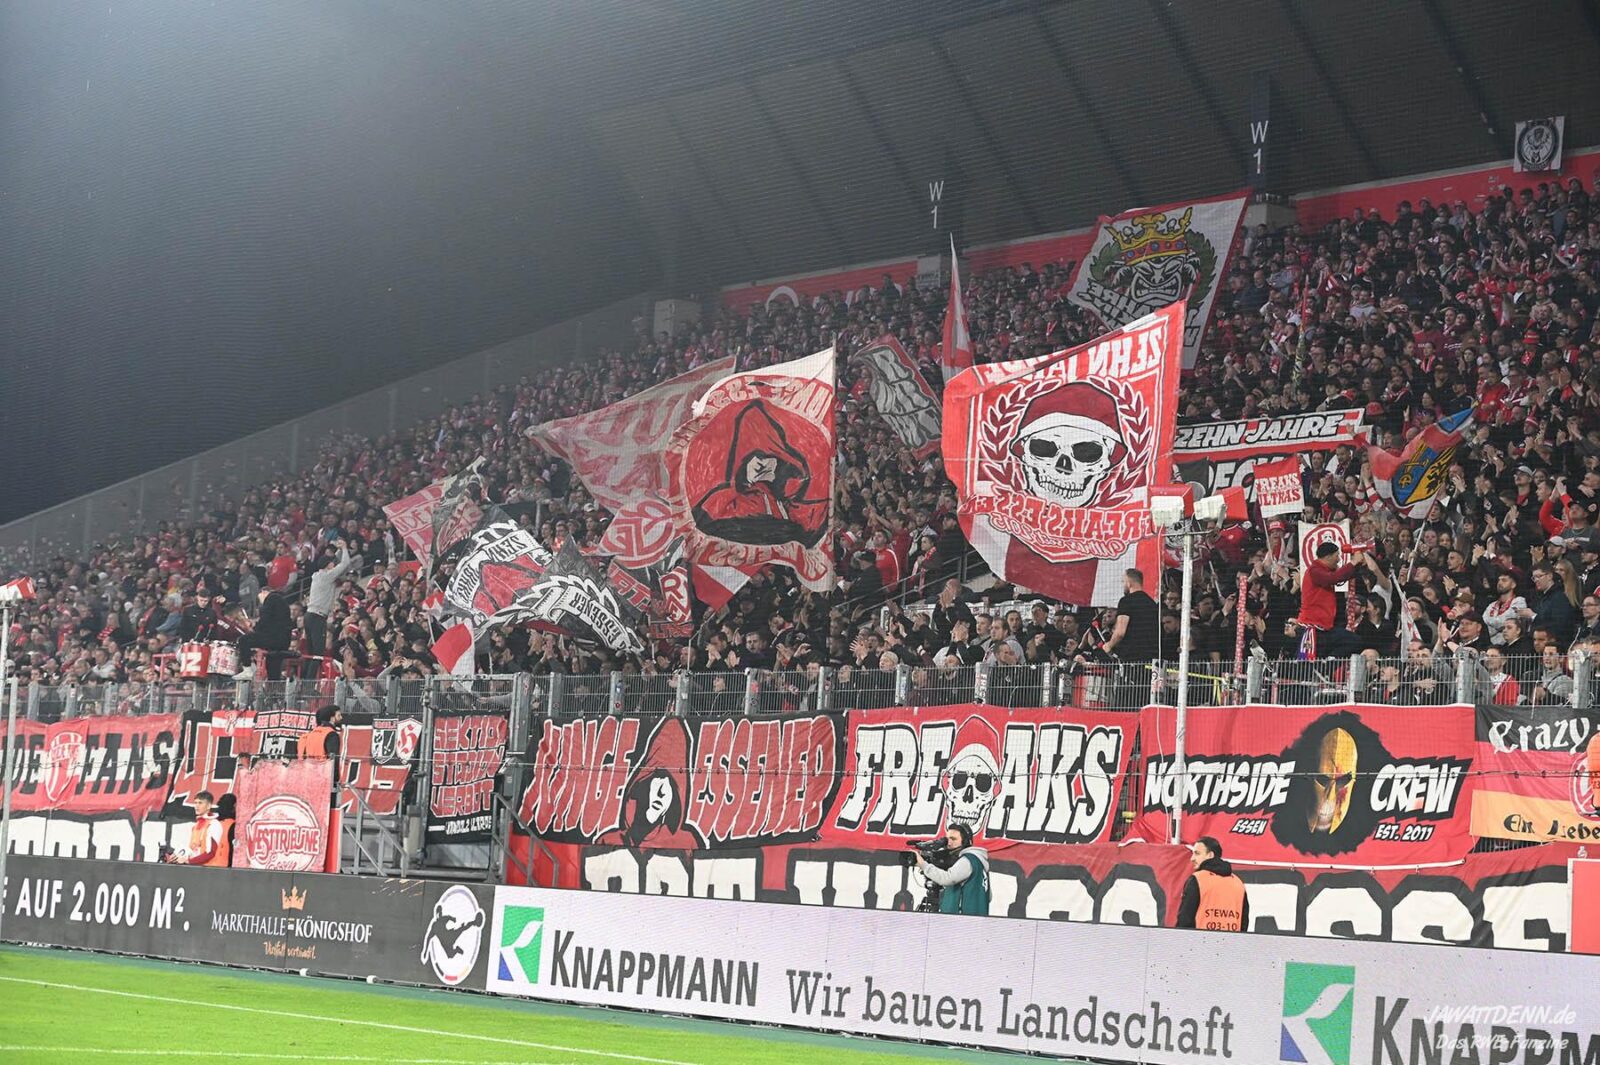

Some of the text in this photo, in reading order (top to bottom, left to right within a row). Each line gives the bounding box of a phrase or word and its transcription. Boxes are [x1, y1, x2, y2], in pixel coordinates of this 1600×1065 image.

[1251, 121, 1269, 144] W
[1253, 148, 1262, 174] 1
[929, 180, 944, 201] W
[930, 205, 938, 229] 1
[1175, 413, 1346, 448] ZEHN JAHRE
[1255, 473, 1300, 493] FREAKS
[1257, 488, 1301, 506] ULTRAS
[1488, 717, 1591, 755] Crazy
[75, 731, 175, 795] FANS
[518, 716, 641, 837] JUNGE
[688, 714, 838, 842] ESSENER
[430, 779, 495, 818] VERBOT
[836, 721, 1123, 843] FREAKS
[1144, 760, 1462, 813] NORTHSIDE CREW
[1232, 818, 1266, 835] ESSEN
[1375, 824, 1434, 841] EST. 2011
[15, 877, 63, 919] AUF
[69, 880, 140, 927] 2.000
[1205, 908, 1240, 920] STEWAD
[211, 909, 374, 944] MARKTHALLE KÖNIGSHOF
[550, 929, 1235, 1059] KNAPPMANN Wir bauen Landschaft
